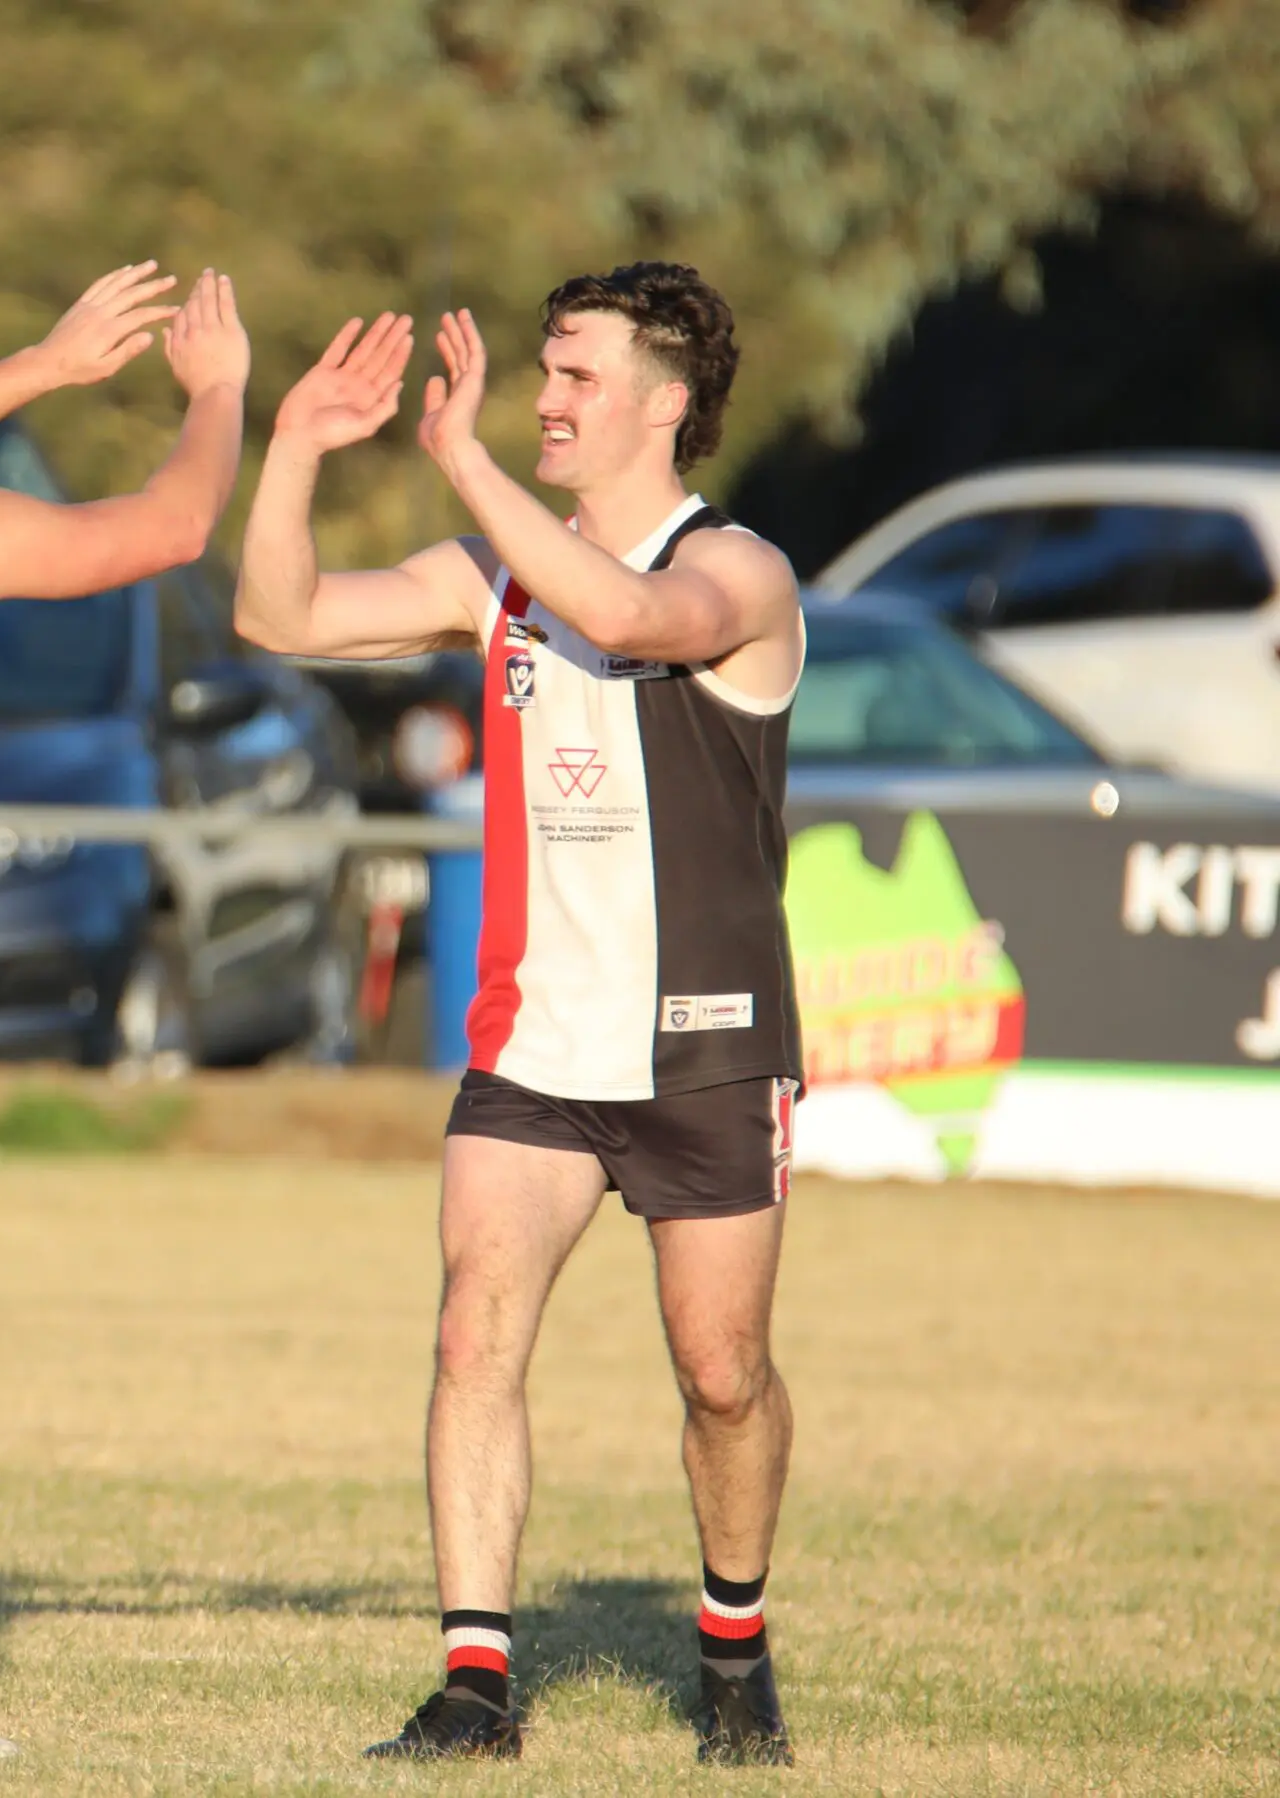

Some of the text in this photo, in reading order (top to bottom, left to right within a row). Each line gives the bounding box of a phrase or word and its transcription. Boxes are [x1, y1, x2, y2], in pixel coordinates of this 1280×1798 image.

[571, 805, 640, 815] FERGUSON
[559, 824, 634, 834] SANDERSON
[547, 834, 613, 842] MACHINERY
